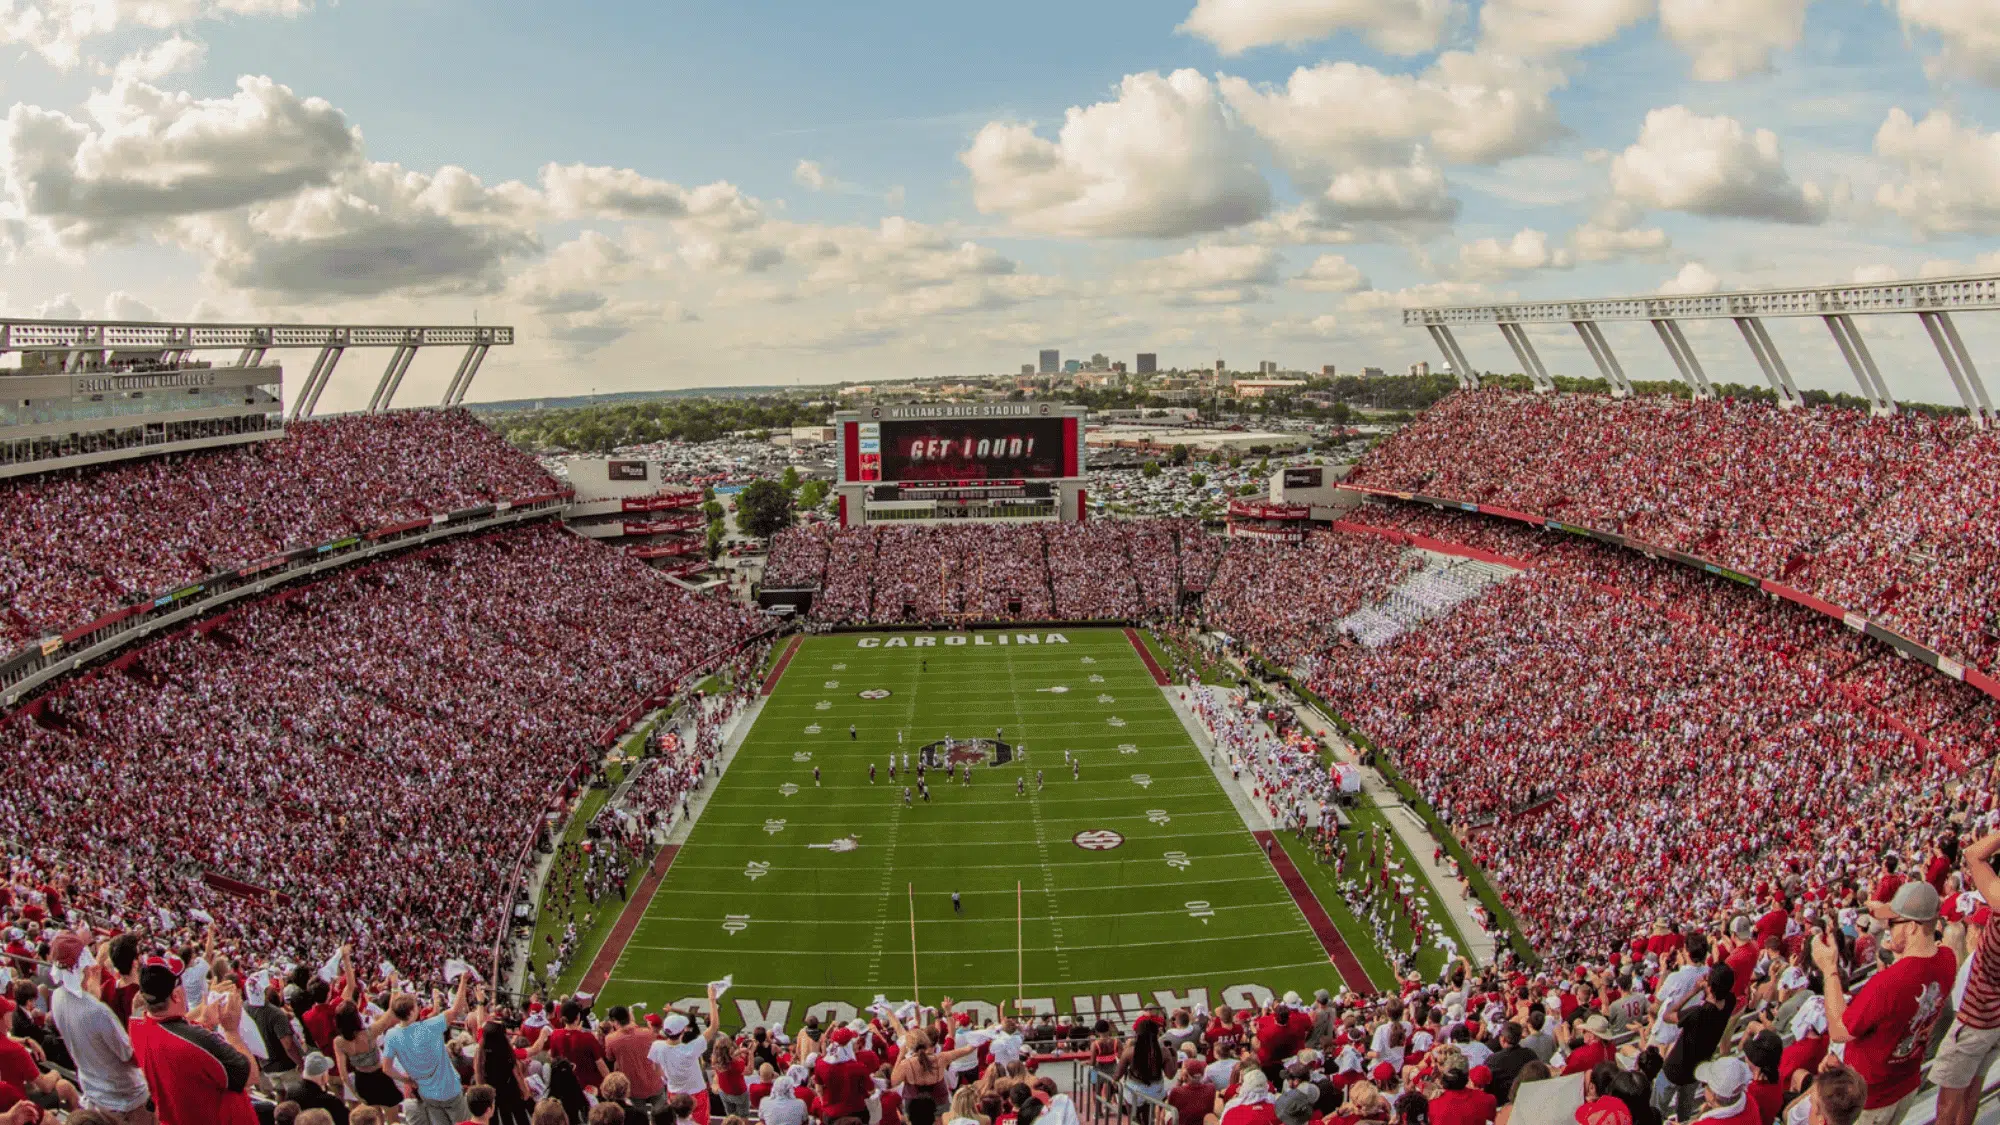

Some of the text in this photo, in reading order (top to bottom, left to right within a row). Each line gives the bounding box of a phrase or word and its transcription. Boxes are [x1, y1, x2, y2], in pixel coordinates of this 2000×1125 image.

[983, 405, 1031, 416] STADIUM
[910, 438, 1034, 460] GET LOUD!
[857, 633, 1069, 648] CAROLINA
[1163, 851, 1191, 867] 20
[744, 861, 770, 876] 20
[1184, 900, 1215, 917] 10
[722, 914, 750, 930] 10
[668, 983, 1276, 1038] GAMECCKS
